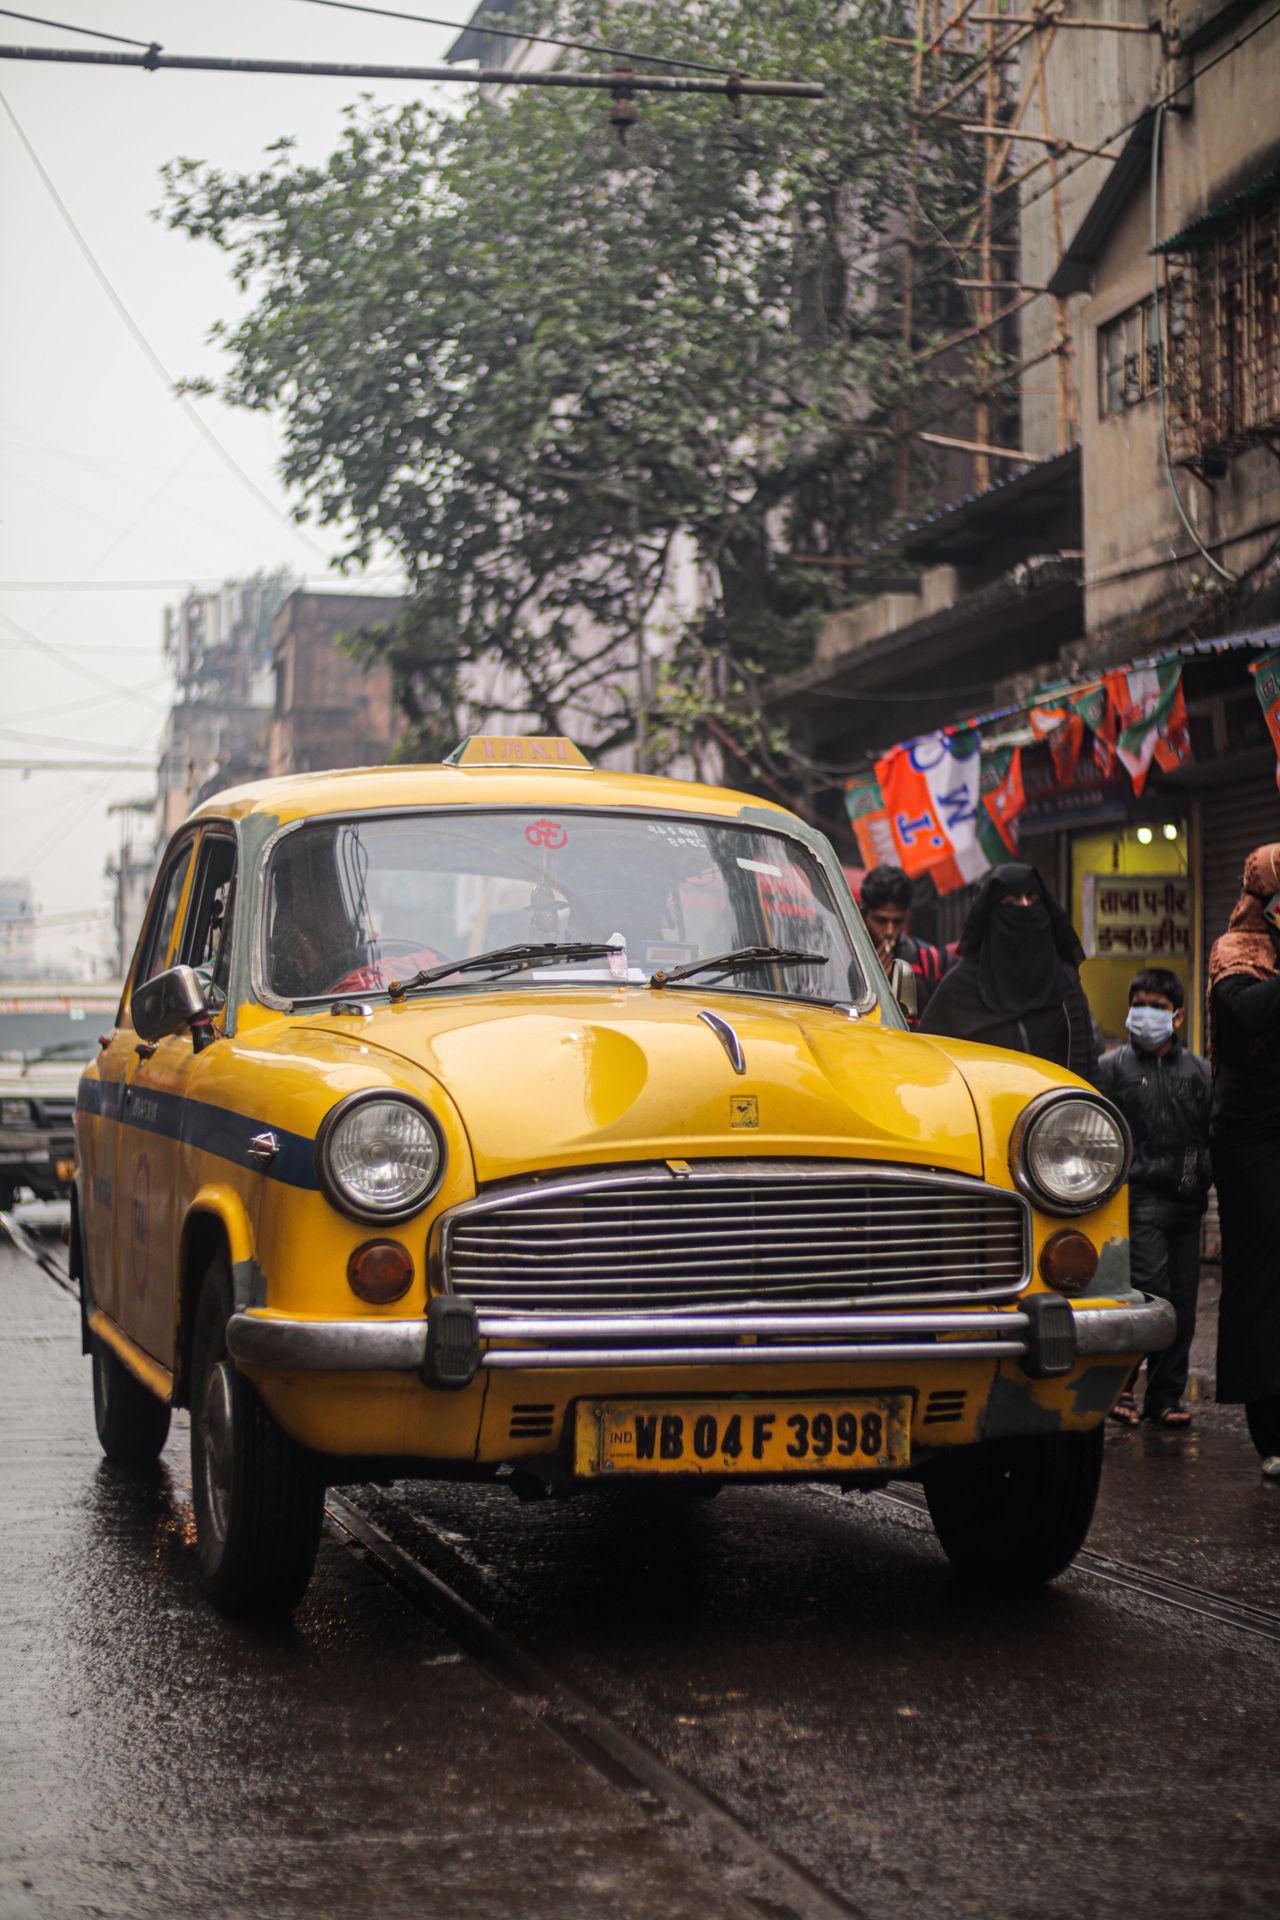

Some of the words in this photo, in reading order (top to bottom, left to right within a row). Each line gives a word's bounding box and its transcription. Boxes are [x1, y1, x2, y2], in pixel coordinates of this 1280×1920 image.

[480, 741, 567, 759] TAXI
[609, 1432, 632, 1444] IND
[634, 1413, 684, 1460] WB
[693, 1414, 744, 1459] 04
[752, 1413, 776, 1460] F
[786, 1411, 882, 1458] 3998
